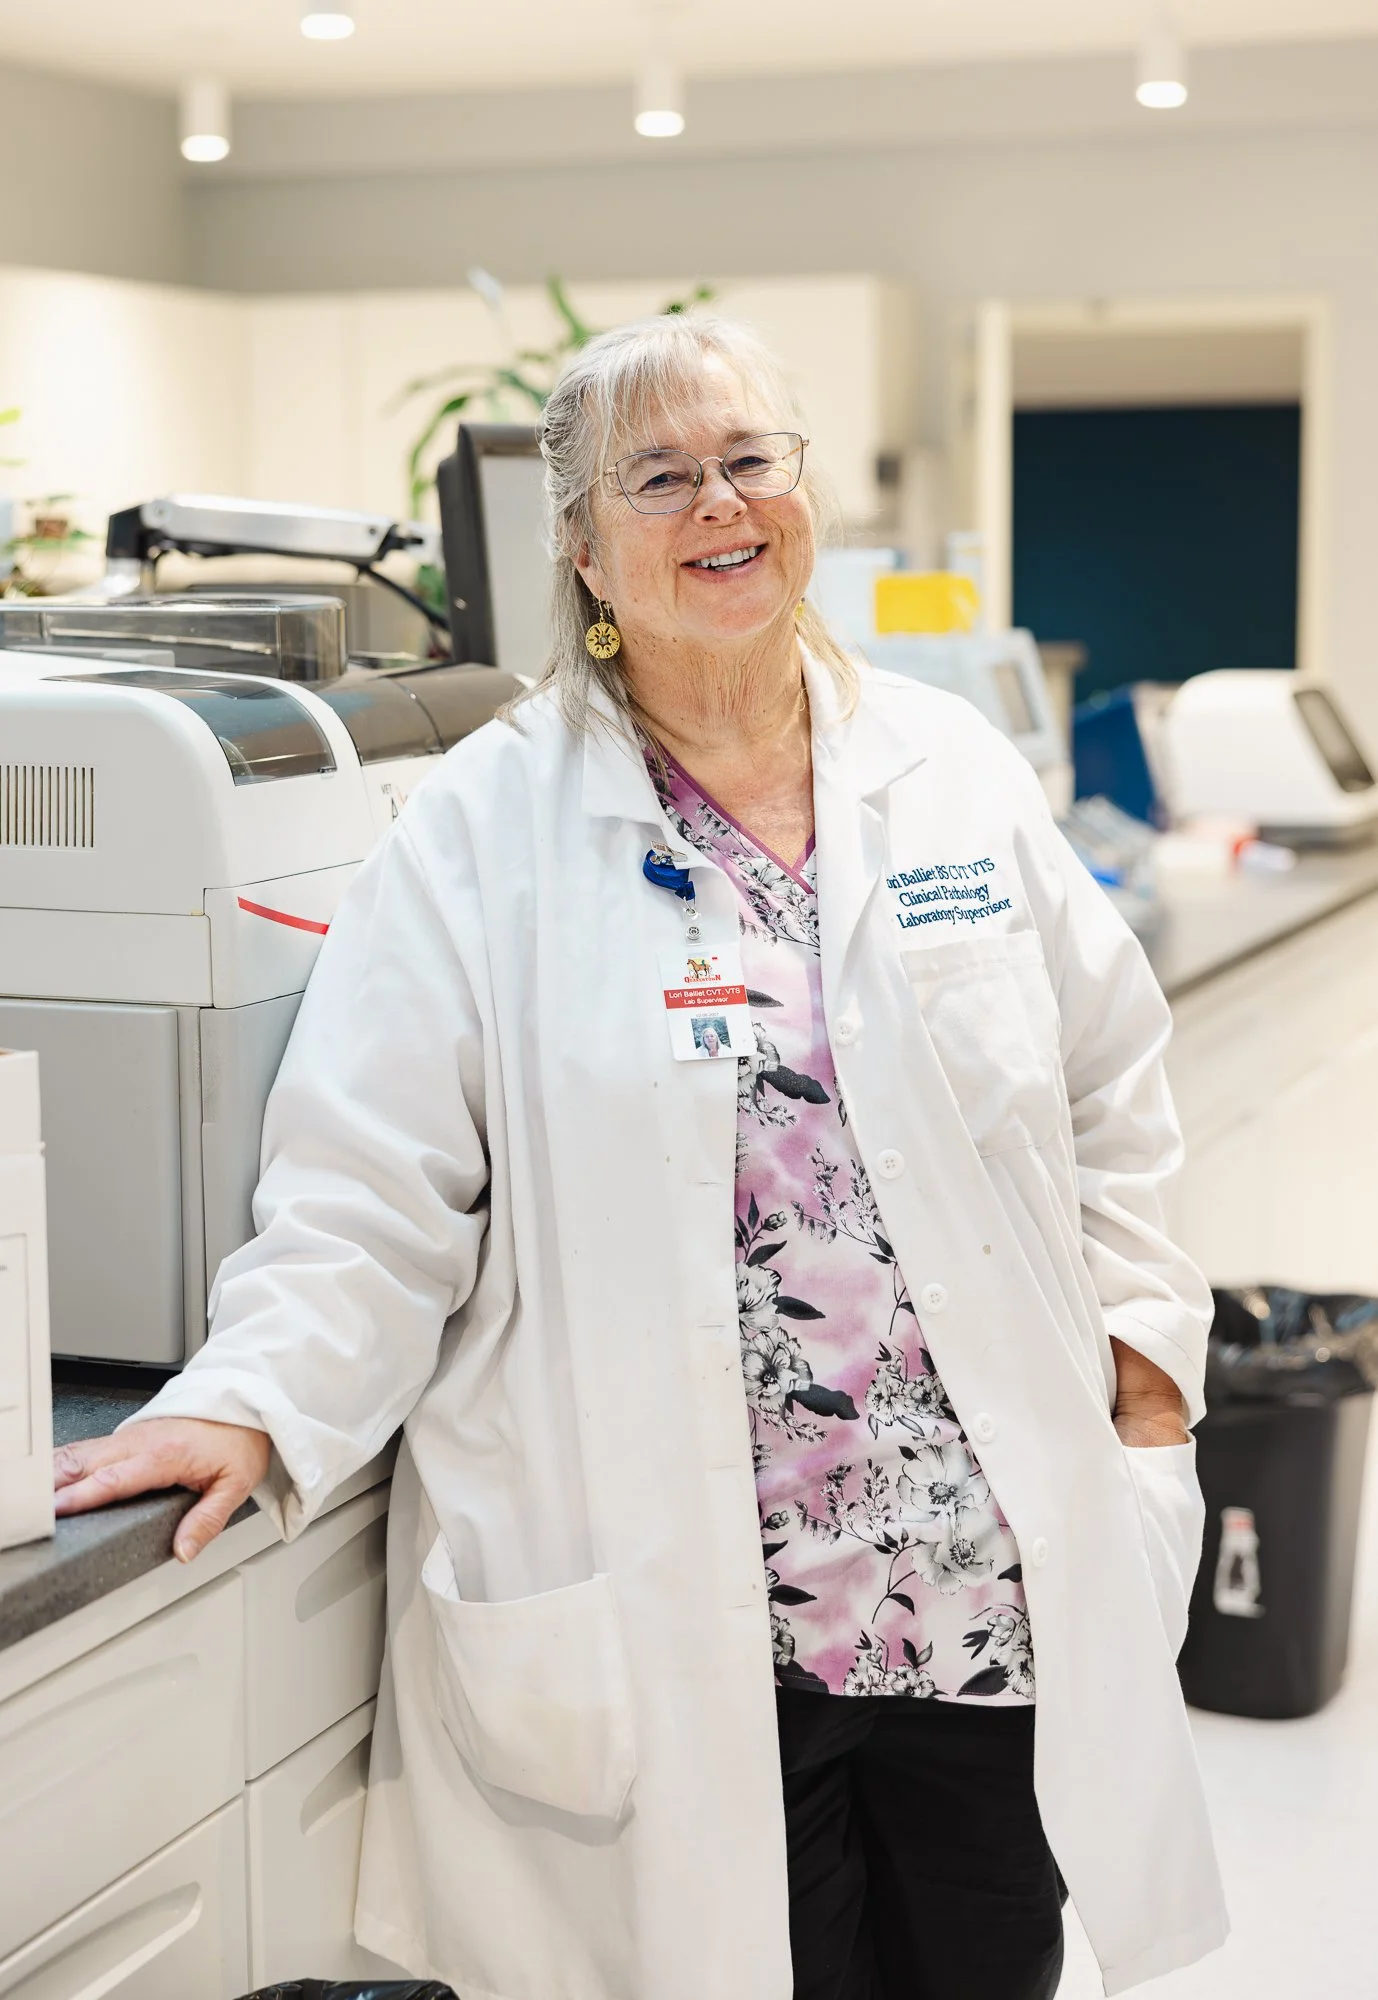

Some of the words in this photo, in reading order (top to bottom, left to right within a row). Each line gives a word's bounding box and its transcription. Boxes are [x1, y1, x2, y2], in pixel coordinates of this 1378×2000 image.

[886, 875, 902, 889] ori
[899, 867, 936, 886] Balliet
[968, 858, 995, 877] VTS
[899, 885, 942, 907] Clinical
[942, 884, 990, 902] Pathology
[896, 909, 956, 928] Laboratory
[953, 898, 1013, 924] Supervisor
